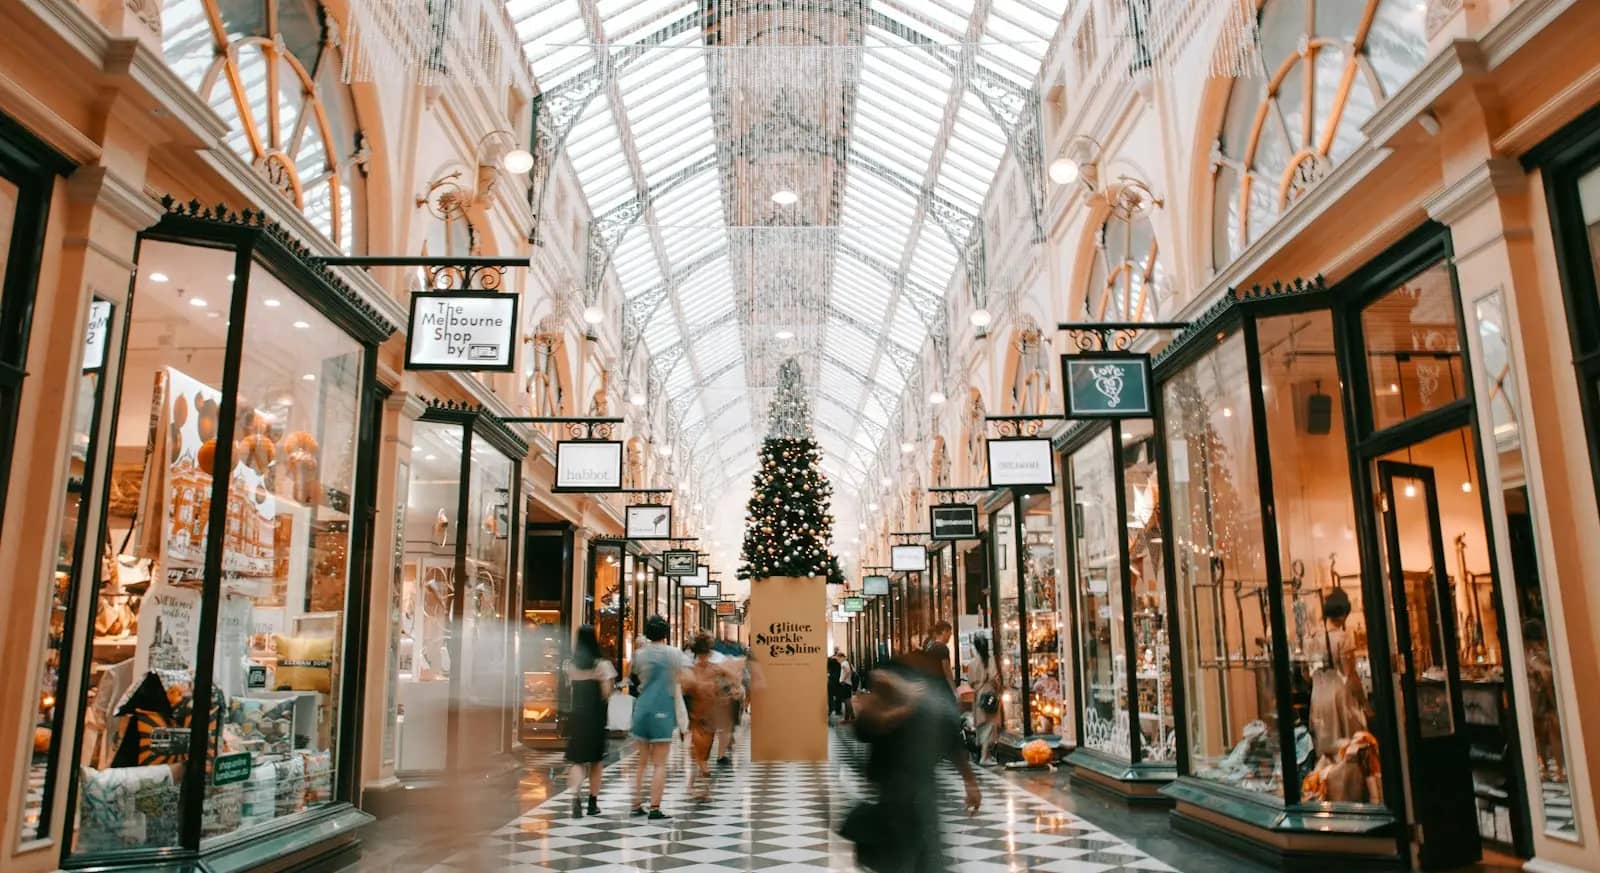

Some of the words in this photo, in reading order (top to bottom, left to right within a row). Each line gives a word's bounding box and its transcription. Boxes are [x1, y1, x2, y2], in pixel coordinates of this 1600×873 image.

[437, 301, 463, 315] The
[421, 313, 504, 327] Melbourne
[434, 327, 472, 344] Shop
[447, 341, 465, 357] by
[756, 633, 804, 645] Sparkle
[785, 643, 821, 656] Shine
